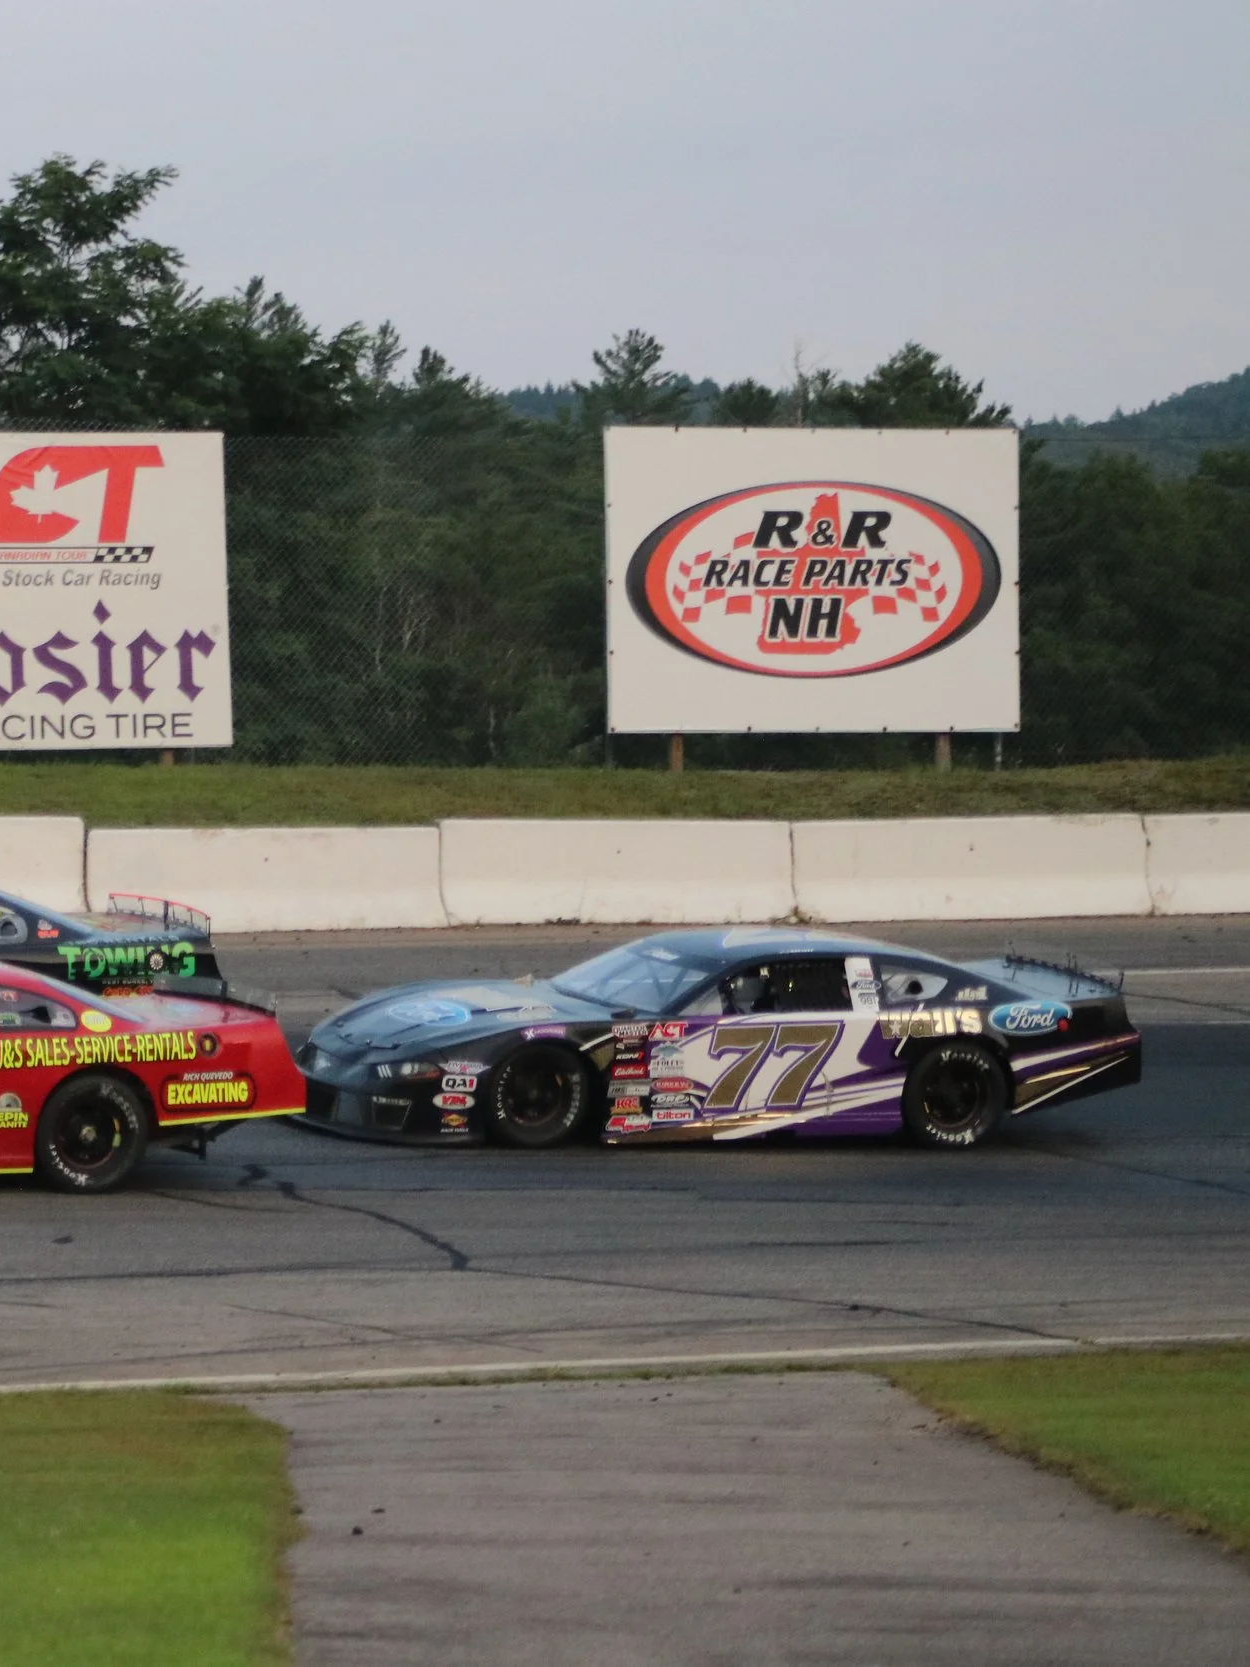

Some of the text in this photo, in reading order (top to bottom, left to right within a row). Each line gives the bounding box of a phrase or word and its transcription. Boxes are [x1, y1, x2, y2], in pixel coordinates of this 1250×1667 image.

[55, 551, 87, 560] TOUR
[2, 569, 55, 587] Stock
[61, 569, 93, 587] Car
[98, 570, 161, 590] Racing
[702, 558, 913, 588] RACE PARTS
[766, 596, 843, 640] NH
[106, 712, 194, 738] TIRE
[1006, 1003, 1054, 1029] Ford
[650, 1022, 688, 1039] ACT
[26, 1031, 197, 1067] SALES-SERVICE-RENTALS
[183, 1071, 234, 1081] RICH QUEVEDO
[702, 1019, 844, 1110] 77
[167, 1082, 249, 1105] EXCAVATING
